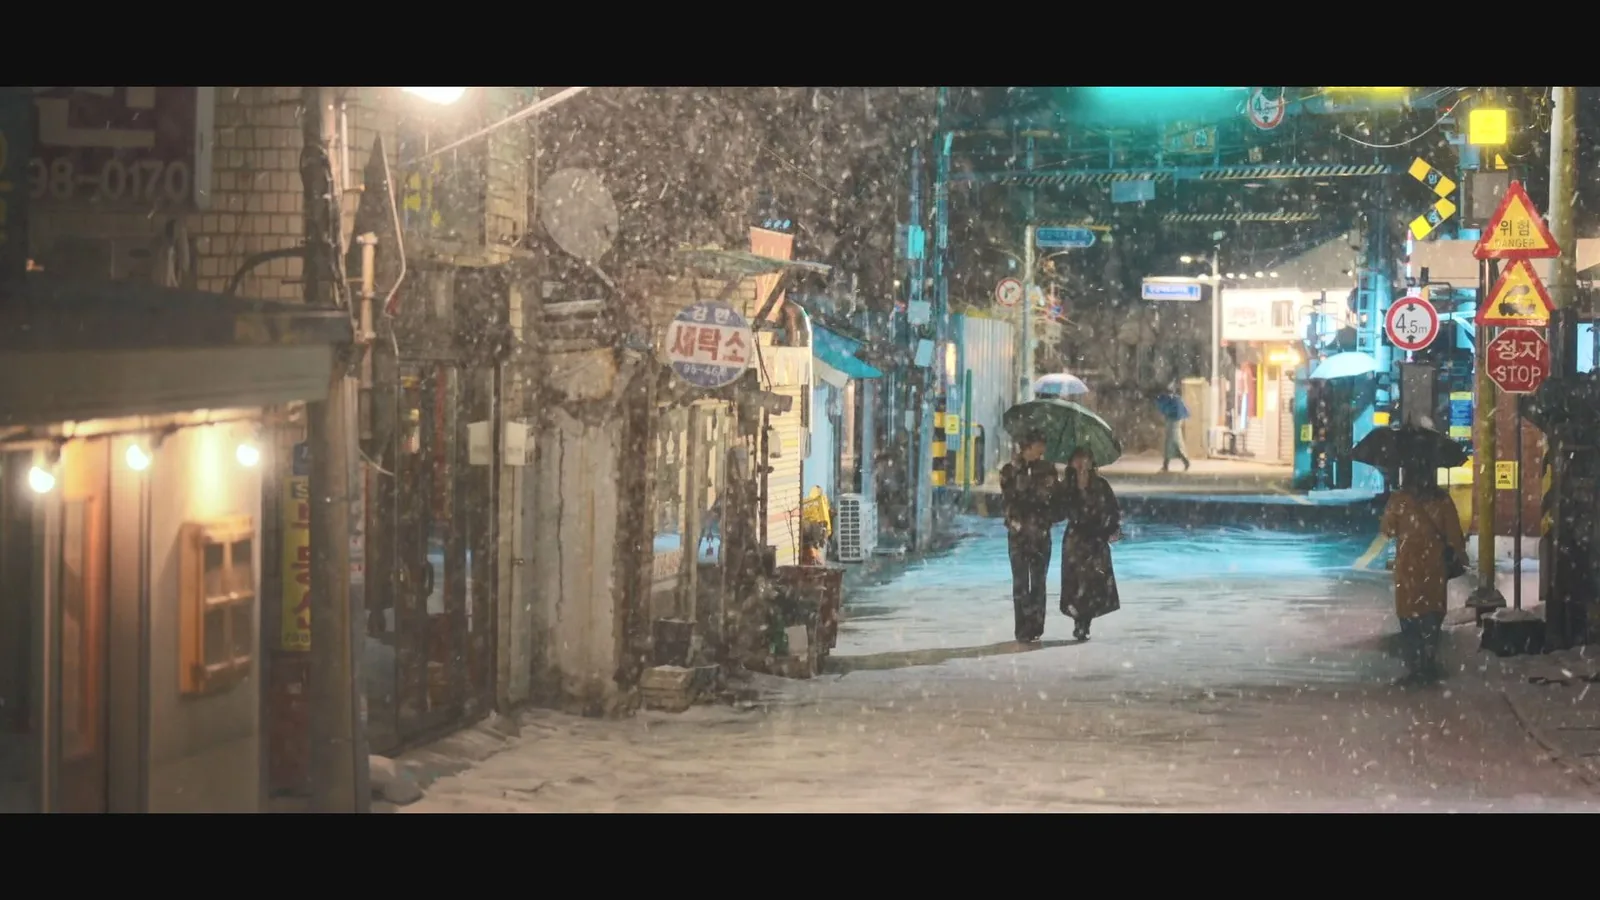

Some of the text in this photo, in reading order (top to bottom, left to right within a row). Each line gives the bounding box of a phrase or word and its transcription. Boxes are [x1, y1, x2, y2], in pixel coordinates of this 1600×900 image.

[1494, 238, 1536, 248] DANGER
[670, 325, 746, 363] 세탁소
[1495, 338, 1541, 361] 정지
[1496, 364, 1541, 384] STOP
